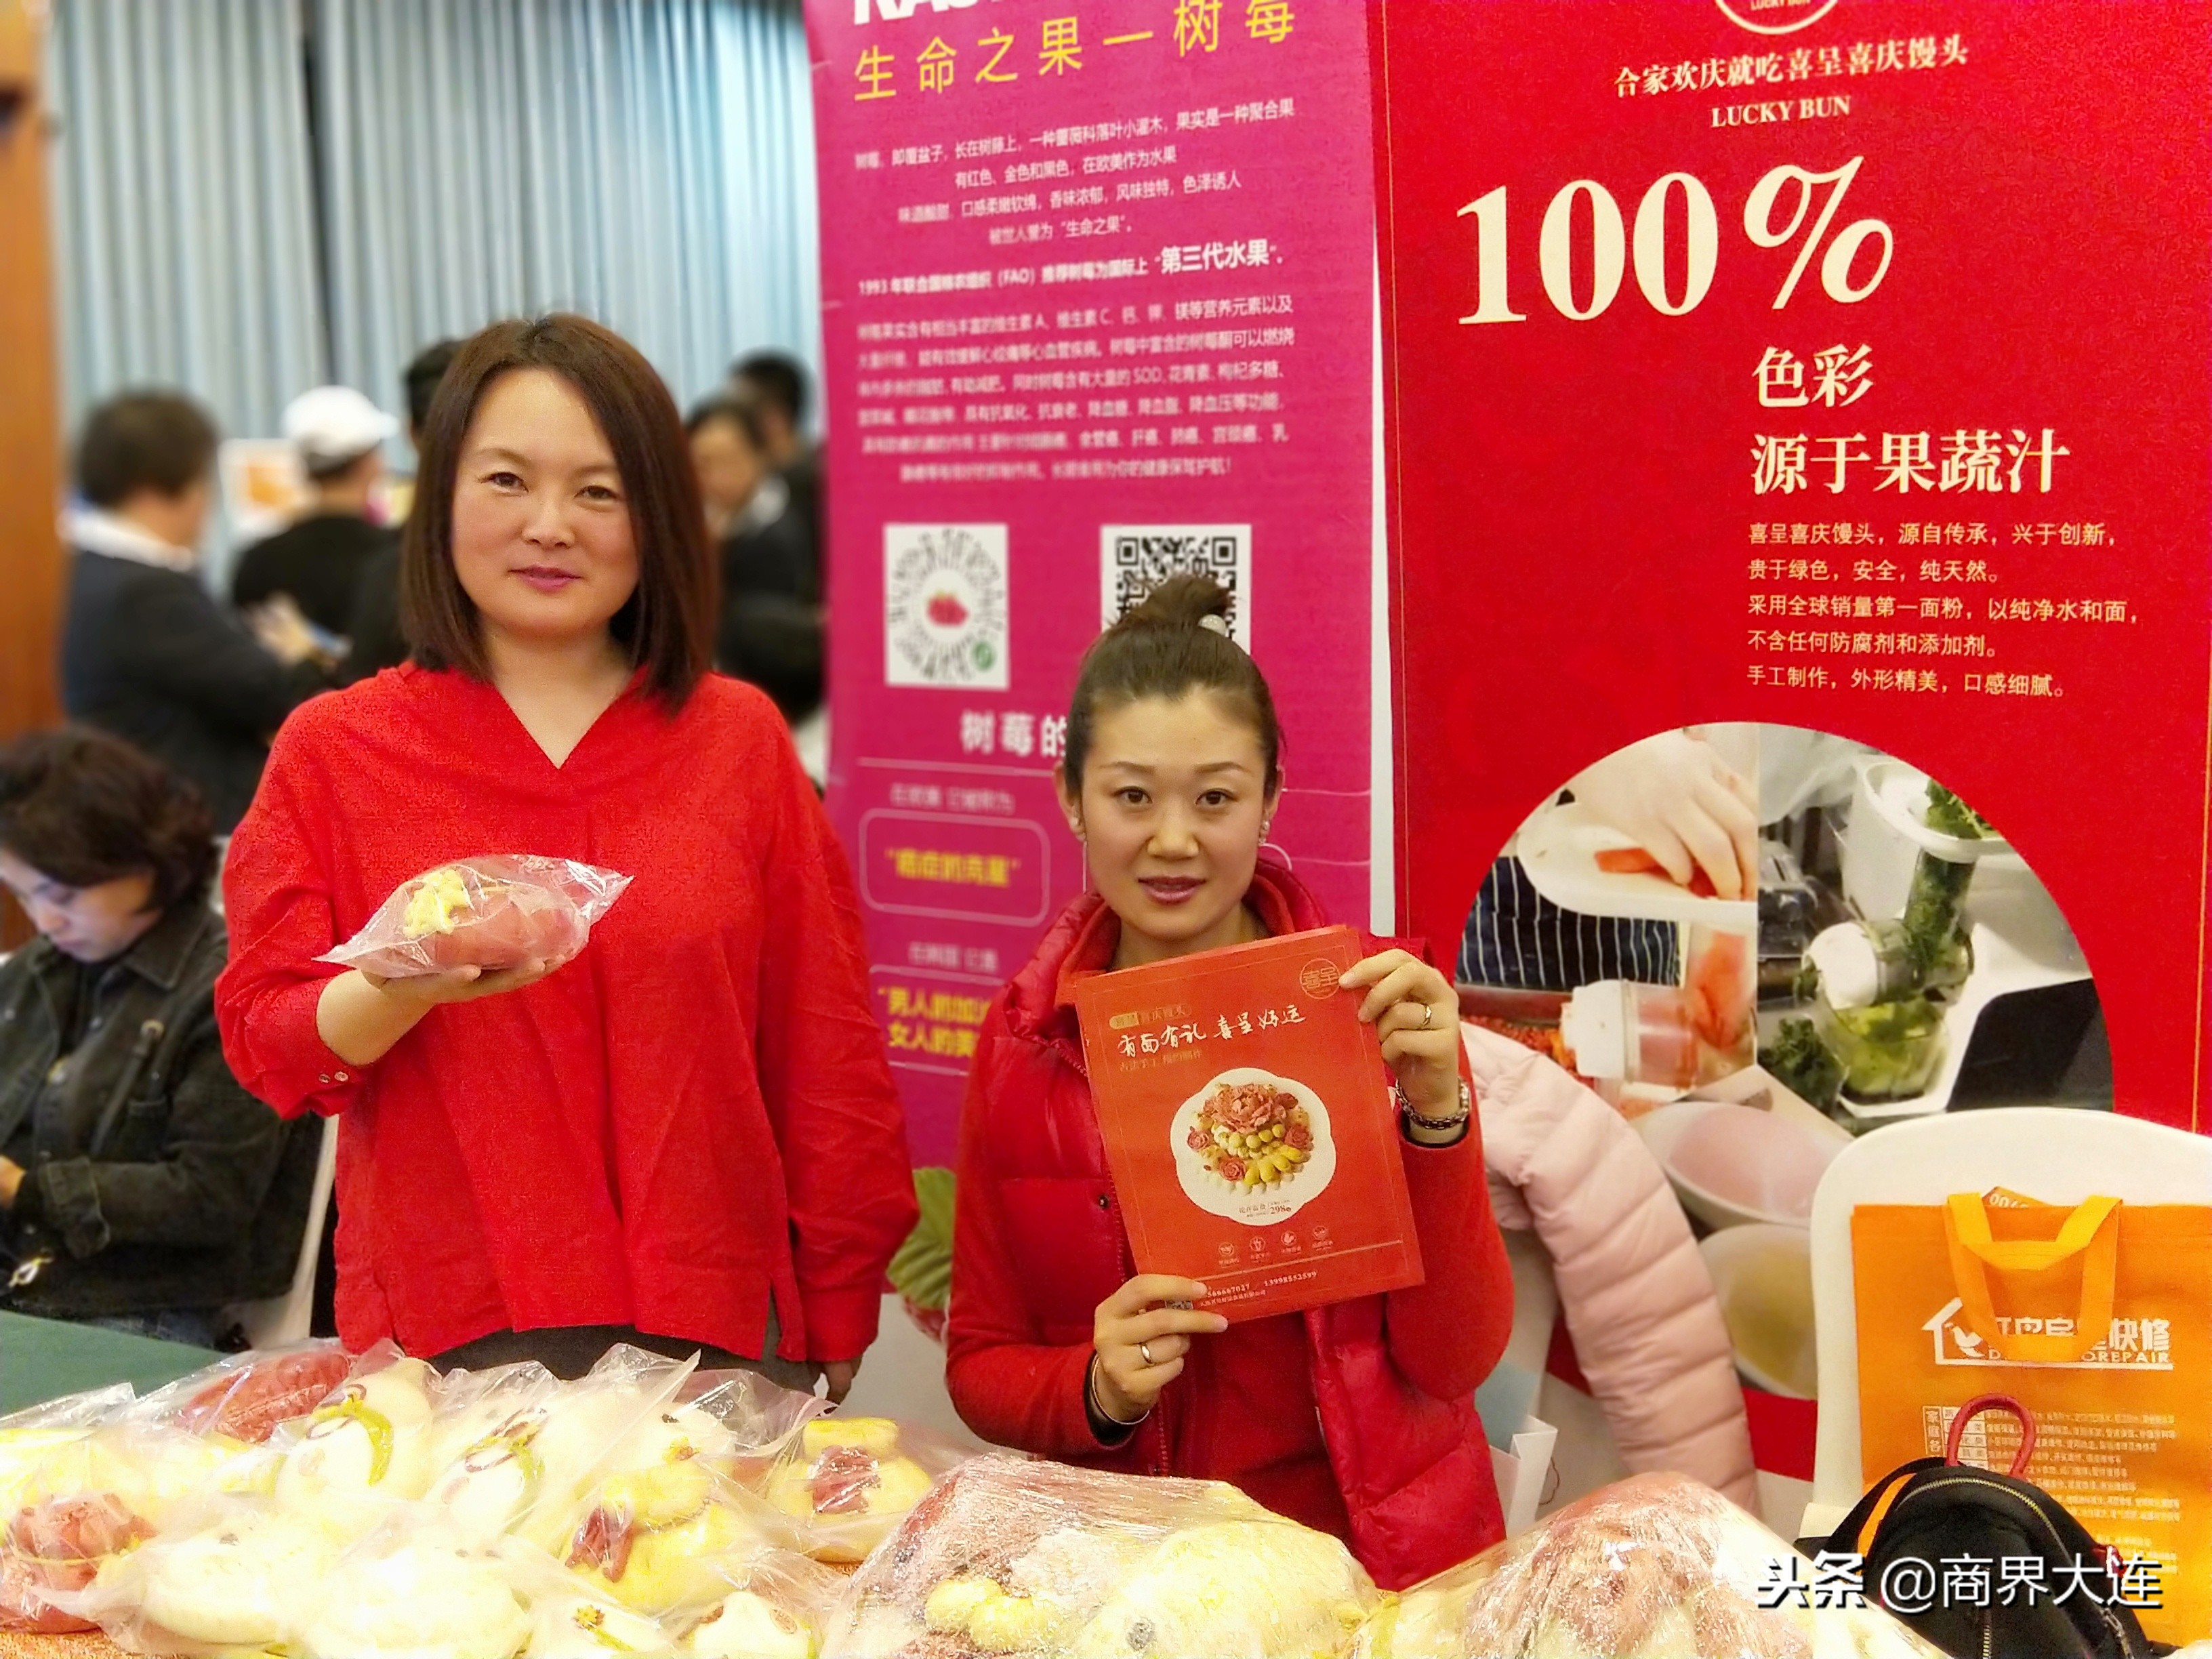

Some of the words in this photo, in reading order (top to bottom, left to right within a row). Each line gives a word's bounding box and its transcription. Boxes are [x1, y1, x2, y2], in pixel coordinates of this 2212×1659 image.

[1614, 34, 1970, 98] 合家欢庆就吃喜呈喜庆馒头
[1711, 101, 1794, 129] LUCKY
[1799, 96, 1852, 121] BUN
[1456, 155, 1894, 327] 100%
[1752, 343, 1875, 408] 色彩
[1750, 428, 2070, 495] 源于果蔬汁
[1748, 522, 2117, 548] 喜呈喜庆馒头，源自传承，兴于创新，
[1748, 559, 1999, 584] 贵于绿色，安全，纯天然。
[1747, 594, 2139, 625] 采用全球销量第一面粉，以纯净水和面，
[1747, 629, 1996, 659] 不含任何防腐剂和添加剂。
[1746, 665, 2064, 699] 手工制作，外形精美，口感细腻。
